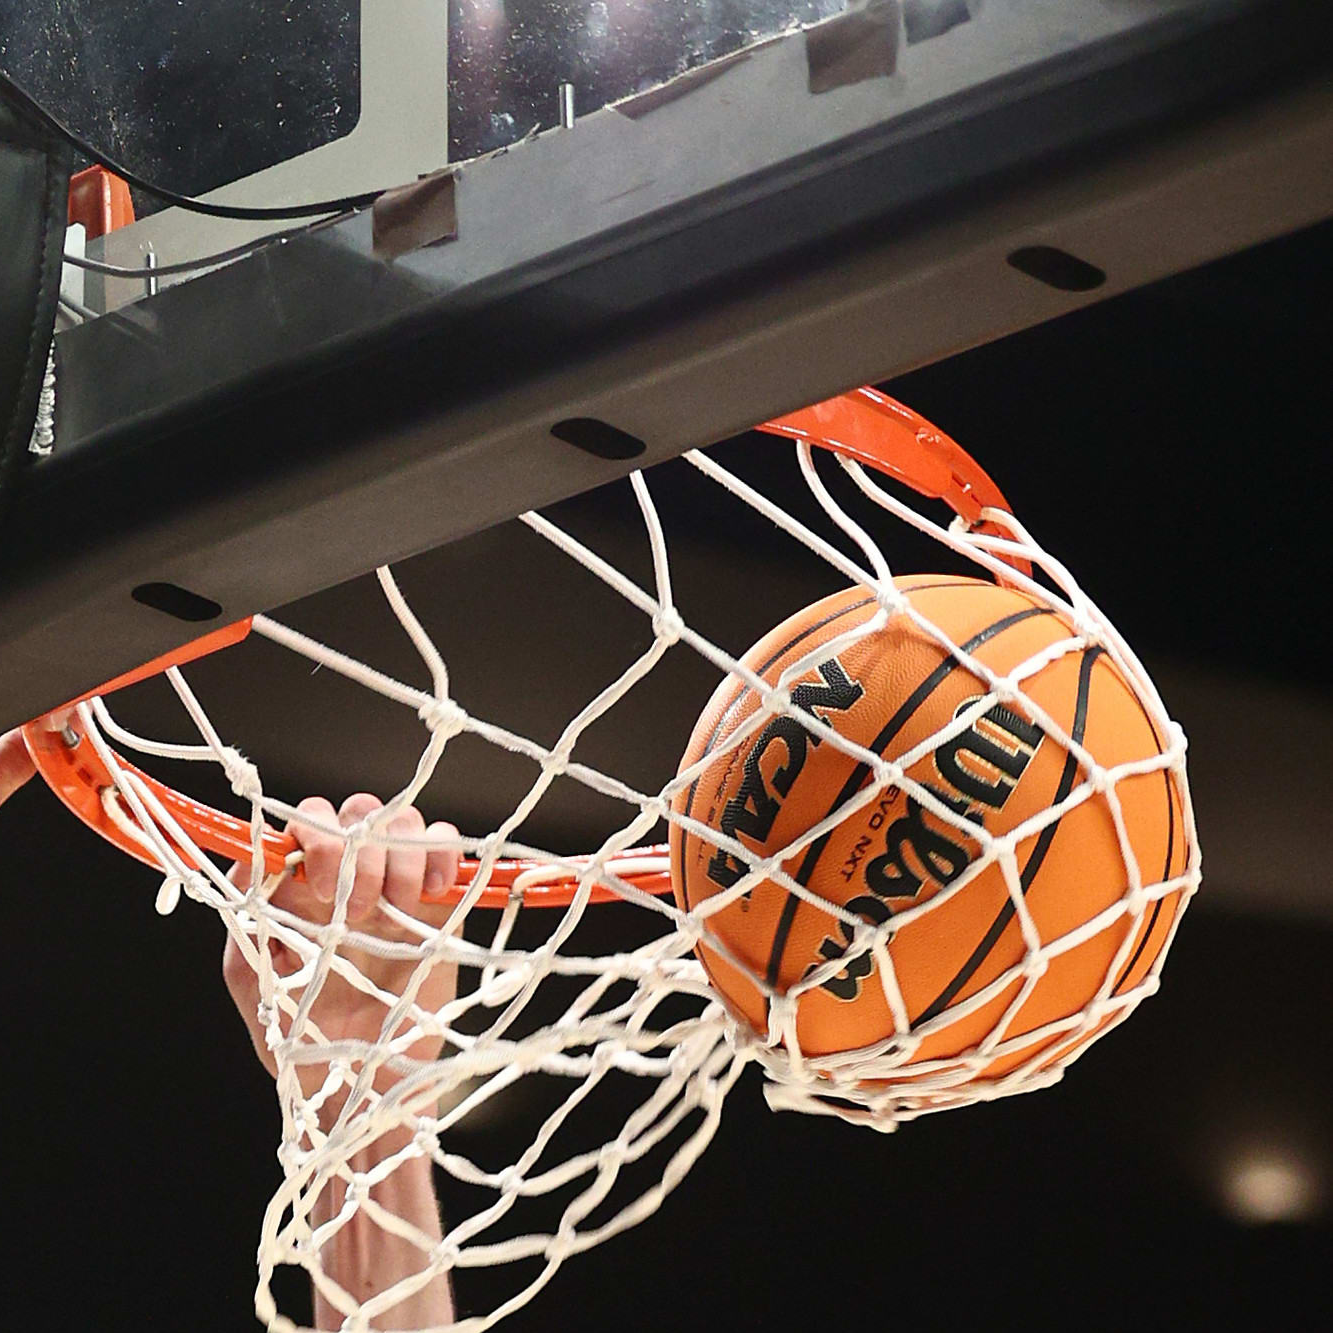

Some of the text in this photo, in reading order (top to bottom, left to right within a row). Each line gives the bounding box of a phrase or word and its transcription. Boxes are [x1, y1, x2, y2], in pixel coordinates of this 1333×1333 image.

[707, 656, 865, 899] NCAA
[802, 693, 1047, 1002] Wilson
[842, 783, 901, 883] EVO NXT
